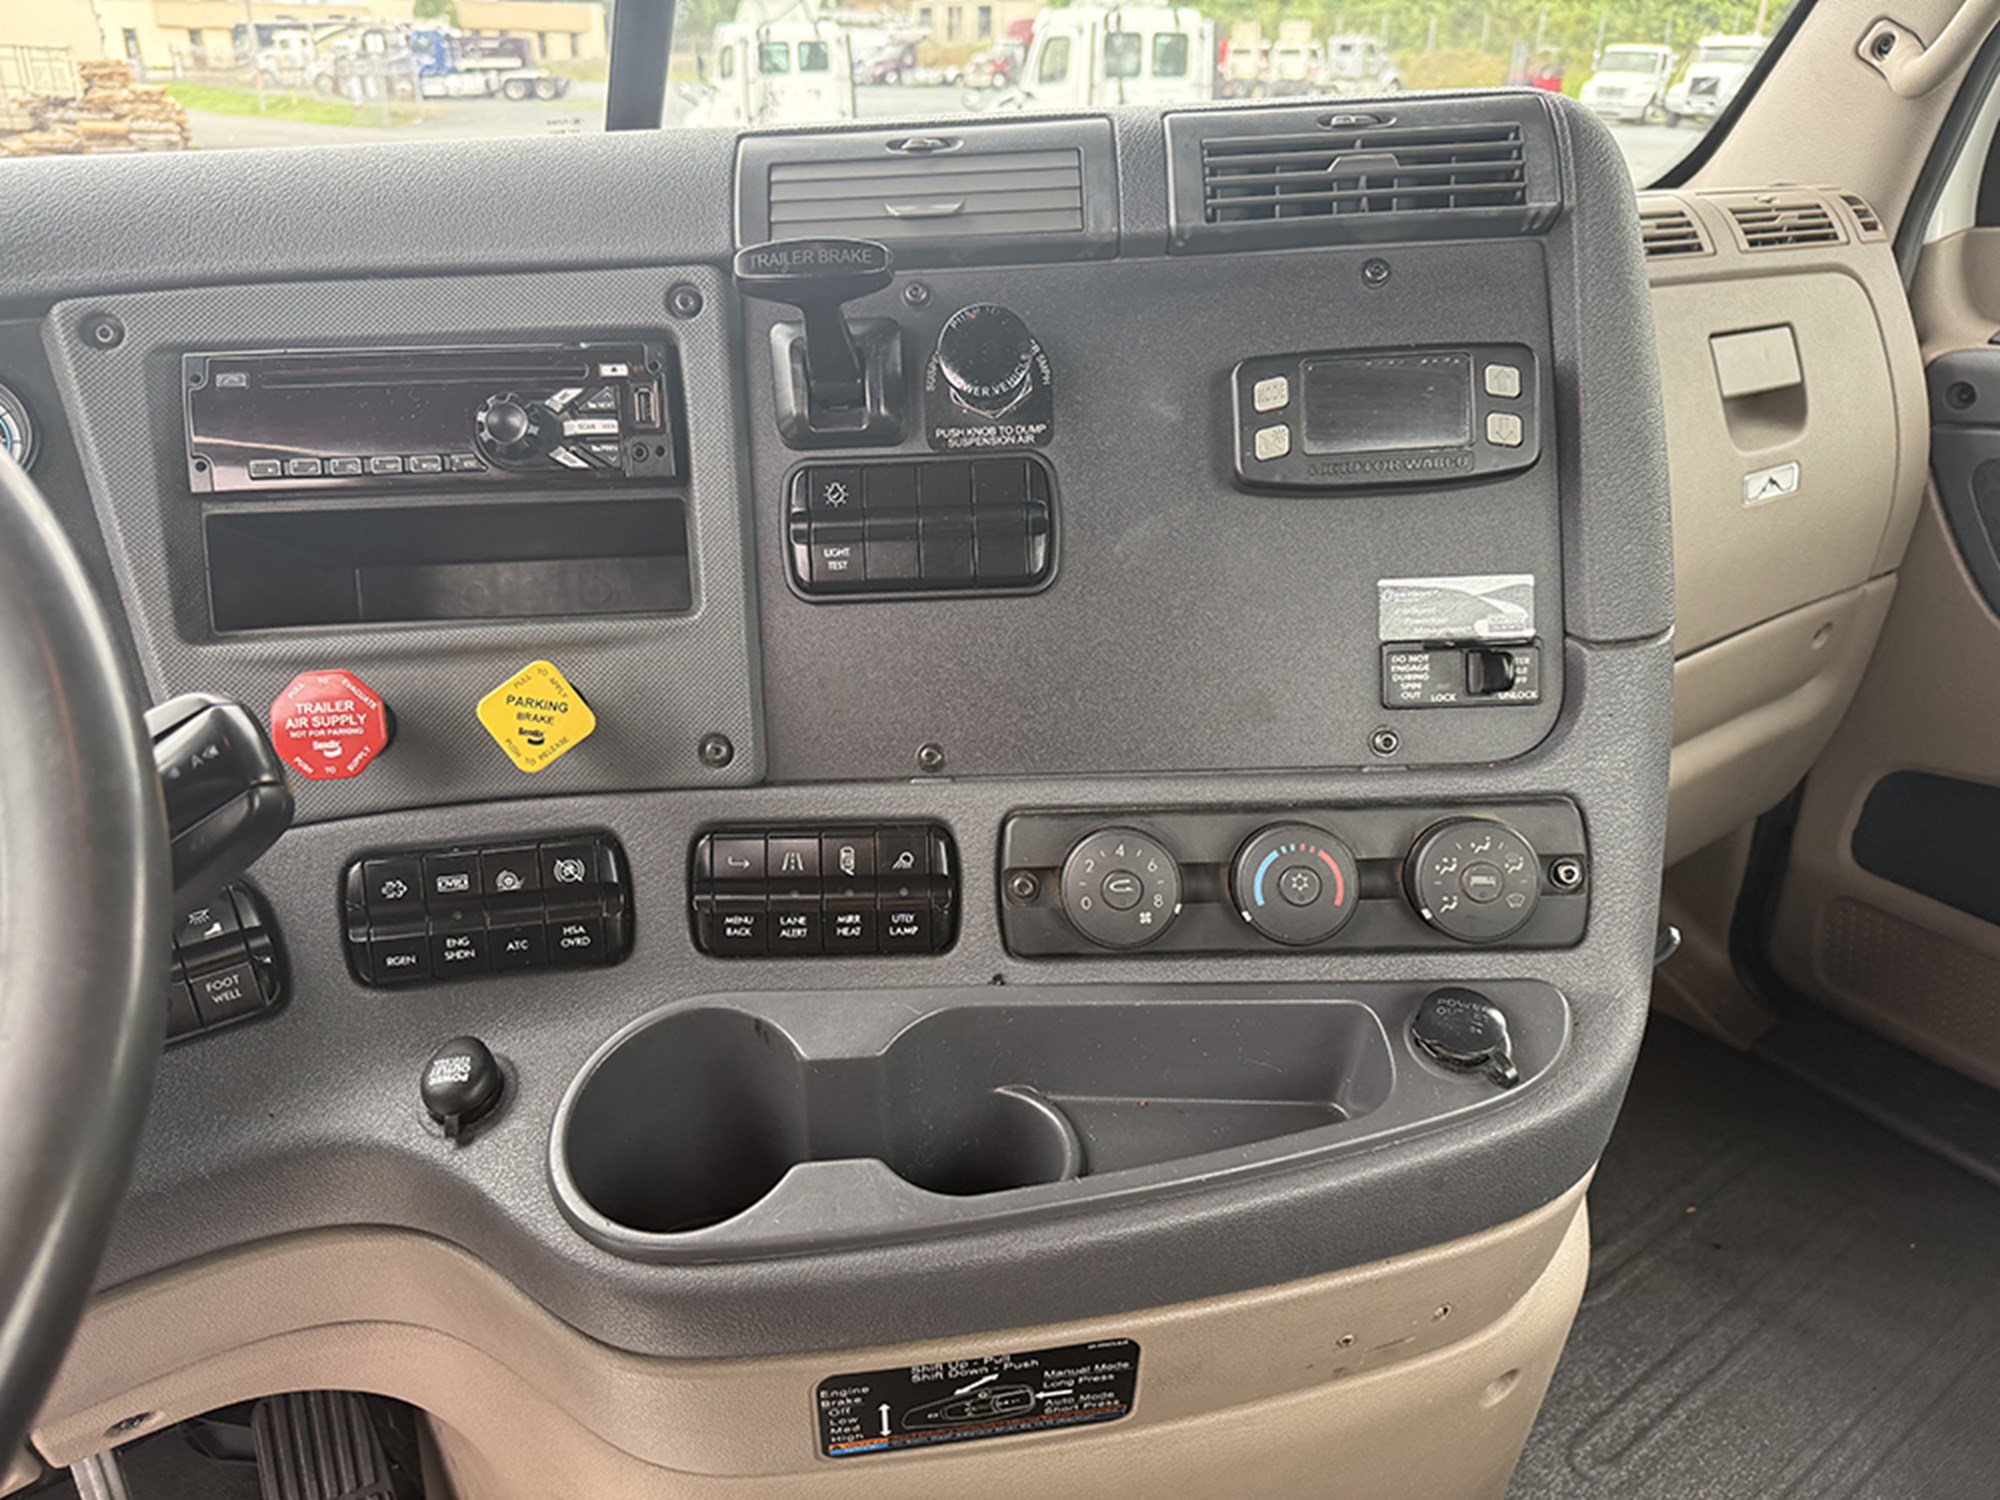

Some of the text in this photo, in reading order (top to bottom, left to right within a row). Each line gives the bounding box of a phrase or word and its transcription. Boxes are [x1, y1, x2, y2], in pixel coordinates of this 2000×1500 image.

[750, 248, 872, 269] TRAILER BRAKE
[936, 427, 965, 438] PUSH
[998, 424, 1014, 435] TO
[1015, 423, 1047, 435] DUMP
[1017, 433, 1036, 444] AIR
[1404, 454, 1470, 473] WABCO
[824, 547, 850, 558] LIGHT
[828, 560, 848, 570] TEST
[1391, 654, 1430, 664] DO NOT
[1390, 664, 1430, 673] ENGAGE
[1391, 673, 1430, 682] DURING
[1401, 691, 1421, 699] OUT
[1431, 693, 1457, 702] LOCK
[1497, 690, 1539, 700] UNLOCK
[296, 700, 355, 714] TRAILER
[505, 694, 569, 714] PARKING
[285, 713, 367, 730] AIR SUPPLY
[516, 712, 555, 726] BRAKE
[290, 727, 364, 738] NOT FOR PARKING
[1115, 844, 1125, 856] 4
[1085, 860, 1095, 873] 2
[1147, 859, 1158, 872] 6
[1080, 896, 1092, 910] 0
[1153, 894, 1164, 908] 8
[724, 915, 755, 925] MENU
[780, 916, 807, 926] LANE
[726, 926, 753, 937] BACK
[780, 928, 808, 938] ALERT
[836, 926, 861, 936] HEAT
[889, 926, 919, 936] LAMP
[446, 937, 471, 949] ENG
[505, 939, 529, 951] ATC
[560, 936, 592, 948] OVRD
[386, 955, 416, 967] RGEN
[444, 949, 476, 961] SHDN
[205, 974, 240, 993] FOOT
[211, 988, 243, 1004] WELL
[948, 1366, 989, 1379] Down
[1003, 1359, 1040, 1371] Push
[1043, 1361, 1130, 1379] Manual Mode
[1043, 1373, 1115, 1389] Long Press
[820, 1385, 870, 1399] Engine
[820, 1397, 862, 1409] Brake
[1044, 1391, 1115, 1407] Auto Mode
[828, 1406, 852, 1417] Off
[1044, 1399, 1120, 1415] Short Press
[829, 1416, 859, 1426] Low
[830, 1424, 861, 1434] Med
[831, 1433, 864, 1443] High
